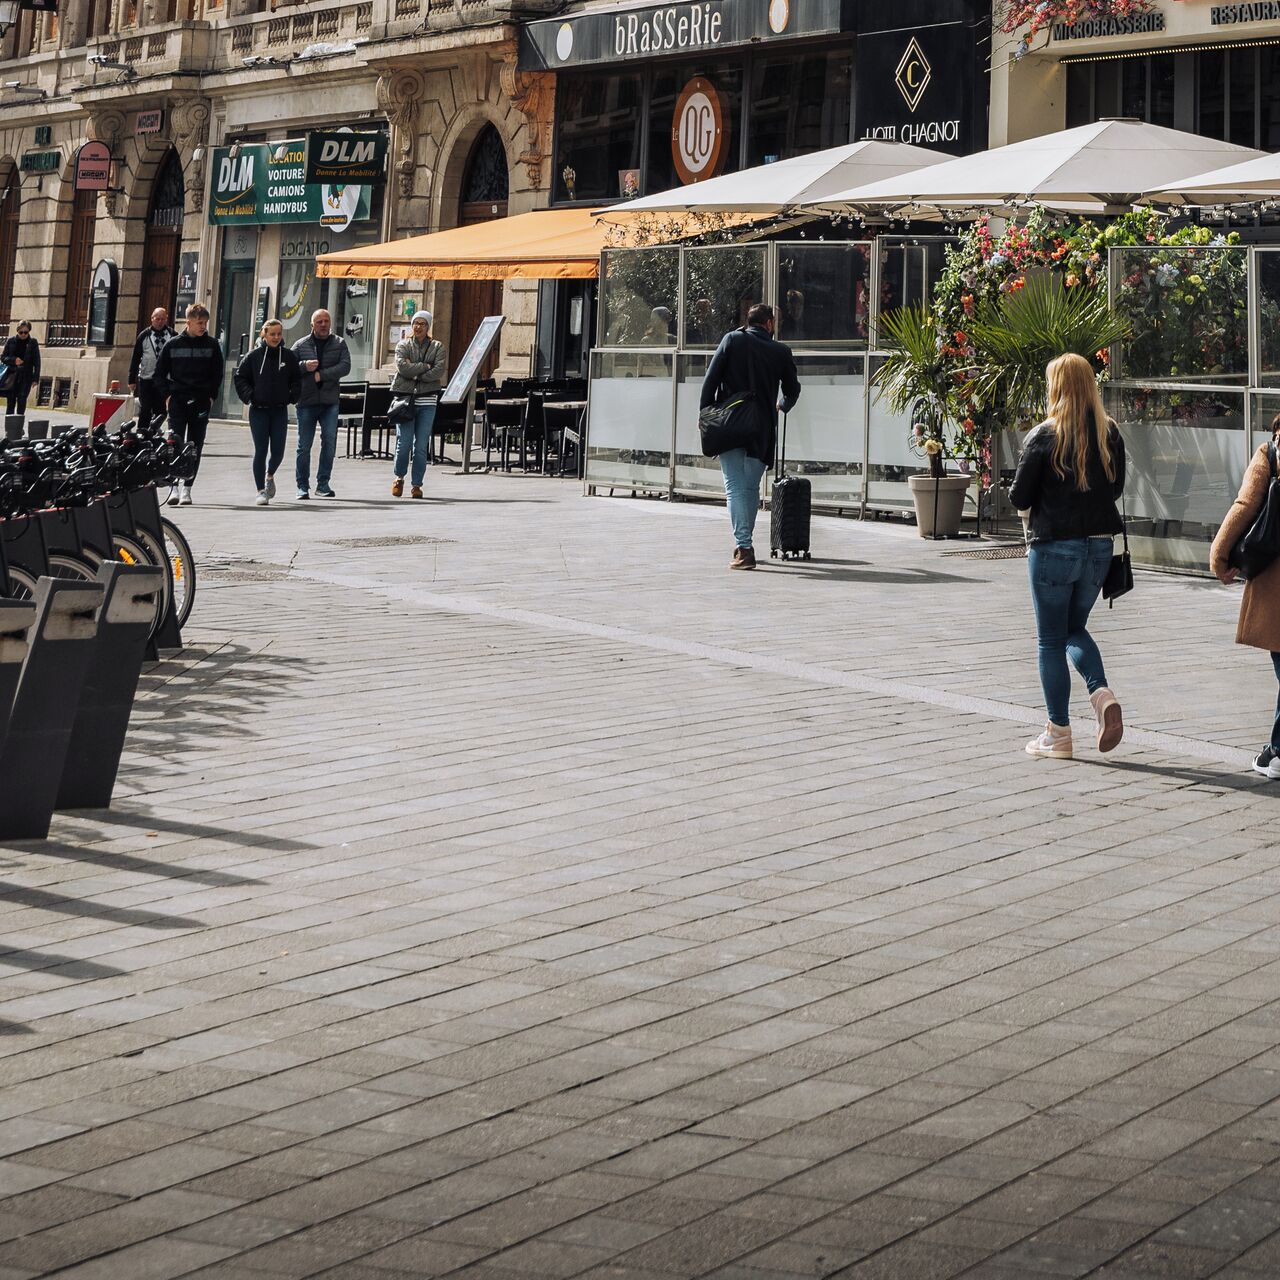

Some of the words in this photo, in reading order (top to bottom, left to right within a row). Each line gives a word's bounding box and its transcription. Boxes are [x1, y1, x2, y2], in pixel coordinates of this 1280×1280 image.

[1052, 12, 1167, 41] MICROBRASSERIE
[684, 105, 712, 164] QG
[900, 120, 960, 144] CHAGNOT
[268, 151, 305, 165] LATIO
[320, 140, 376, 162] DLM
[217, 155, 254, 193] DLM
[316, 168, 337, 176] Donne
[349, 168, 376, 177] Mobilité
[267, 184, 305, 198] CAMIONS
[263, 200, 308, 214] HANDYBUS
[154, 208, 184, 226] RESTAUR
[281, 241, 330, 257] LOCATIO
